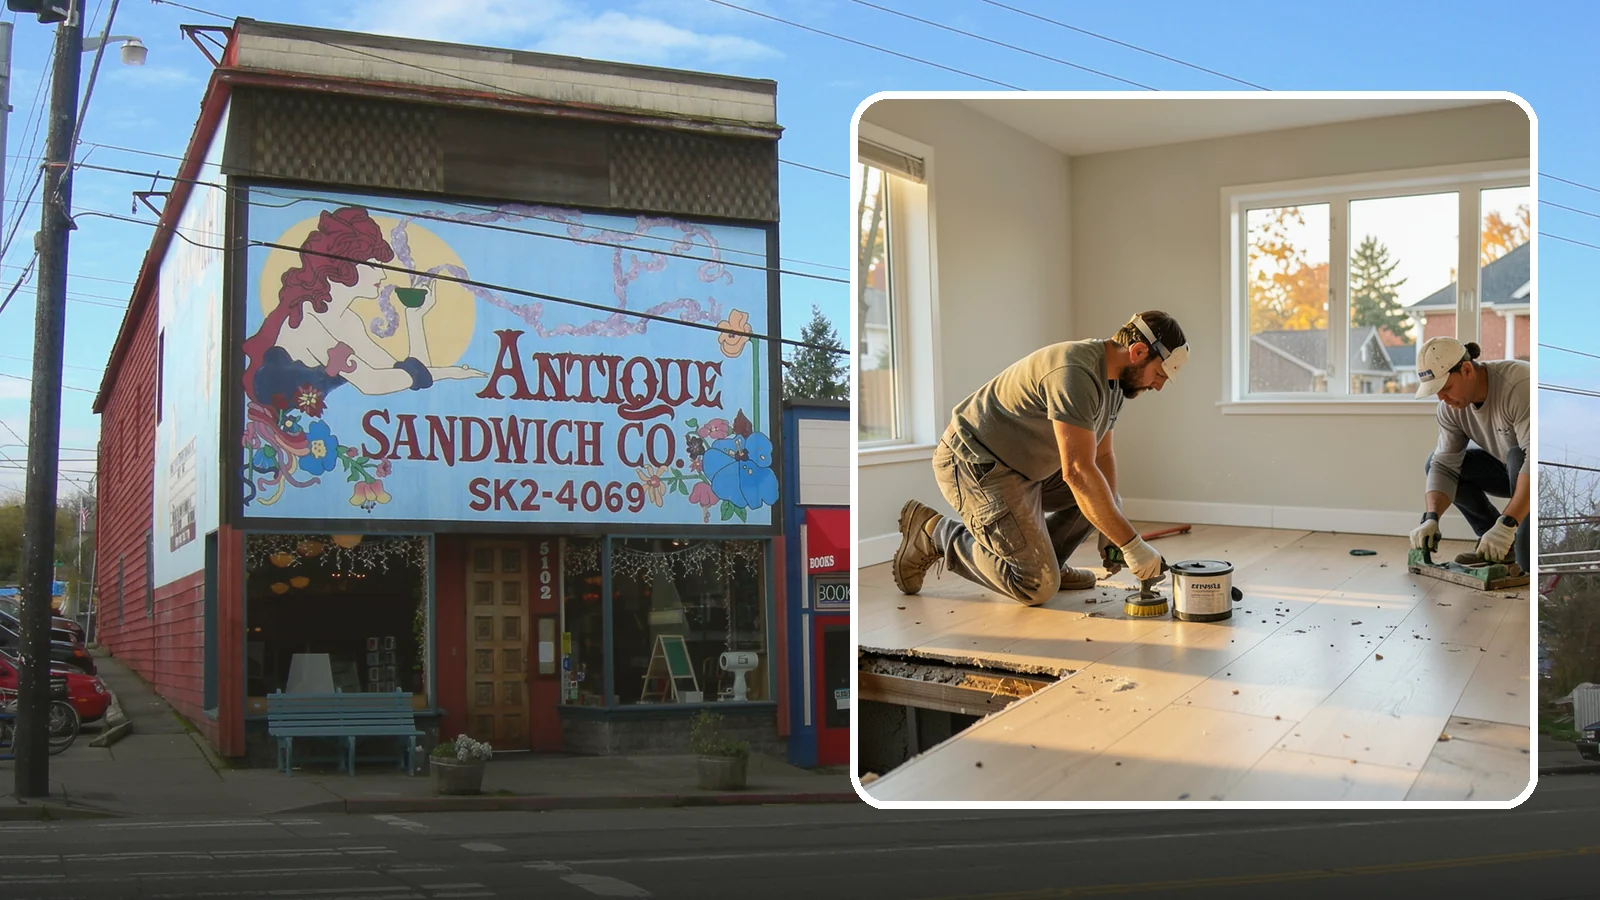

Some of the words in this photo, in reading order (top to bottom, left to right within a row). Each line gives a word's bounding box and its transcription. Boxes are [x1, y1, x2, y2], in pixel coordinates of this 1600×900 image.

[476, 329, 724, 421] ANTIQUE
[361, 409, 604, 466] SANDWICH
[617, 421, 685, 469] CO.
[468, 477, 646, 512] SK2-4069
[540, 542, 551, 599] 5102
[809, 555, 835, 568] BOOKS
